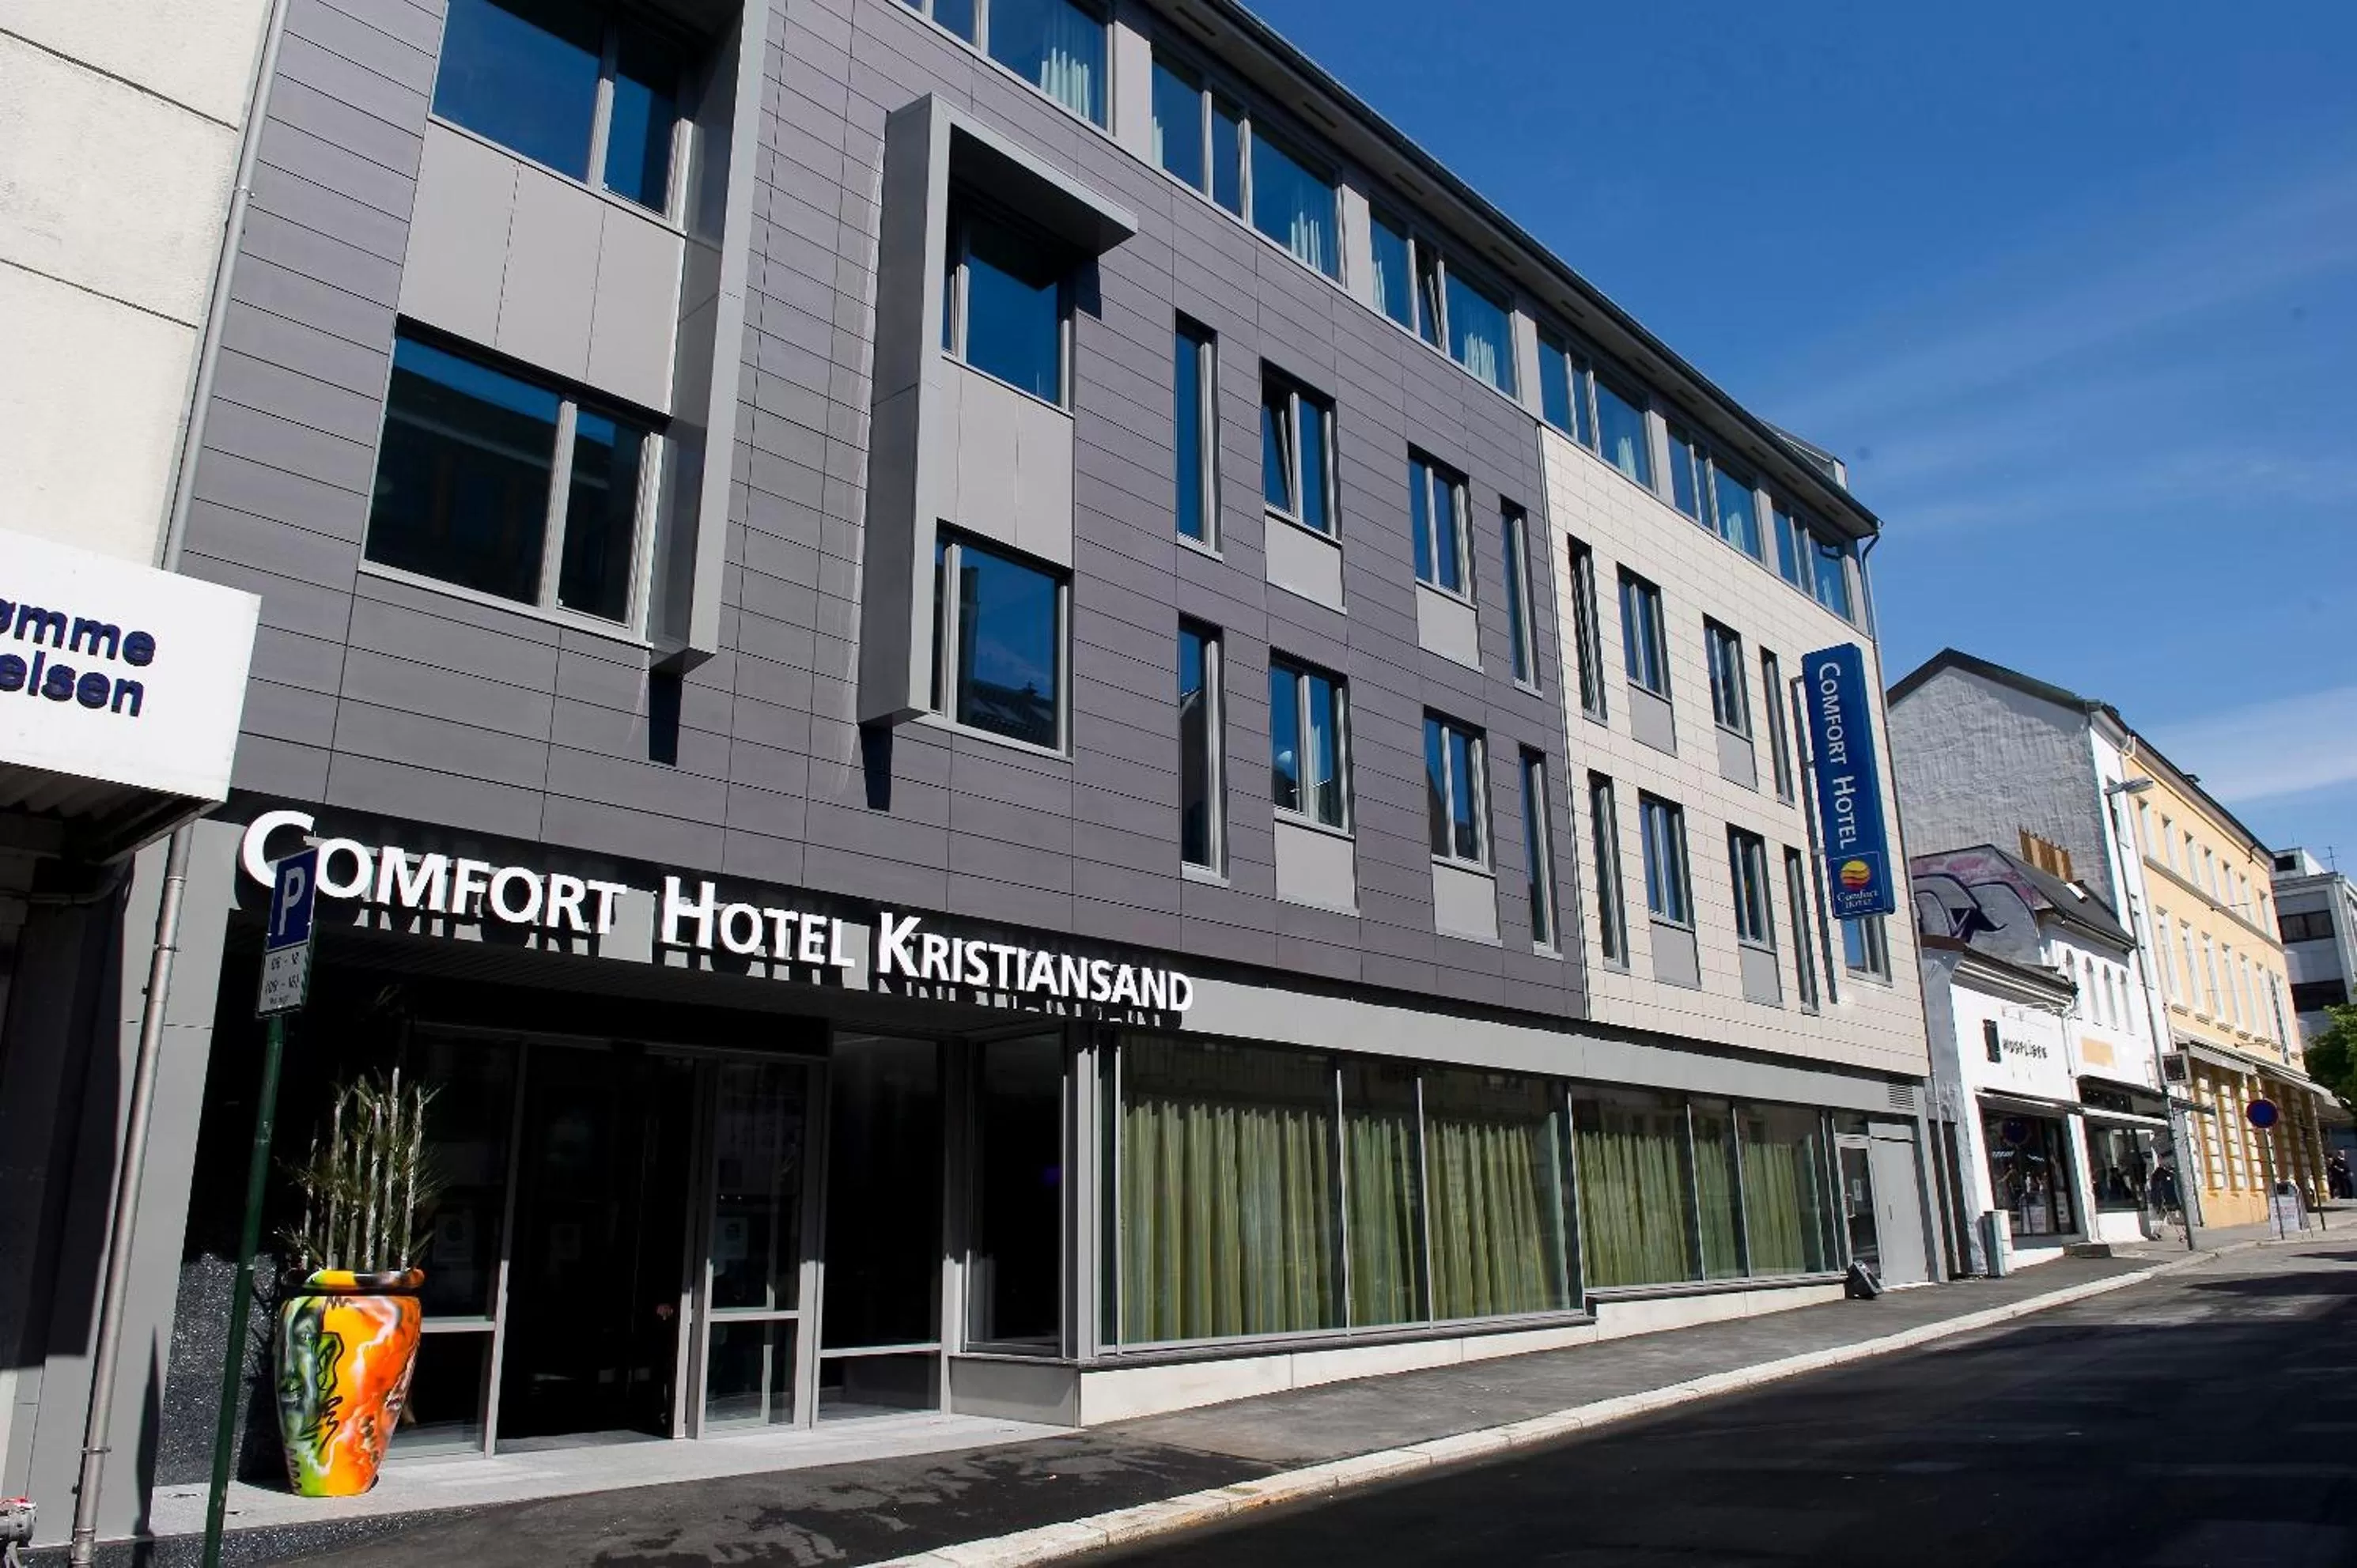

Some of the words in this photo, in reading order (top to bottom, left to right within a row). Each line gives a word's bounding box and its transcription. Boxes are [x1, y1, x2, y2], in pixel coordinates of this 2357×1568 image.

[0, 650, 144, 717] elsen
[1819, 662, 1847, 765] COMFORT
[1833, 775, 1857, 849] HOTEL
[240, 810, 626, 935] COMFORT
[660, 875, 856, 968] HOTEL
[876, 911, 1194, 1012] KRISTIANSAND
[278, 867, 305, 936] P
